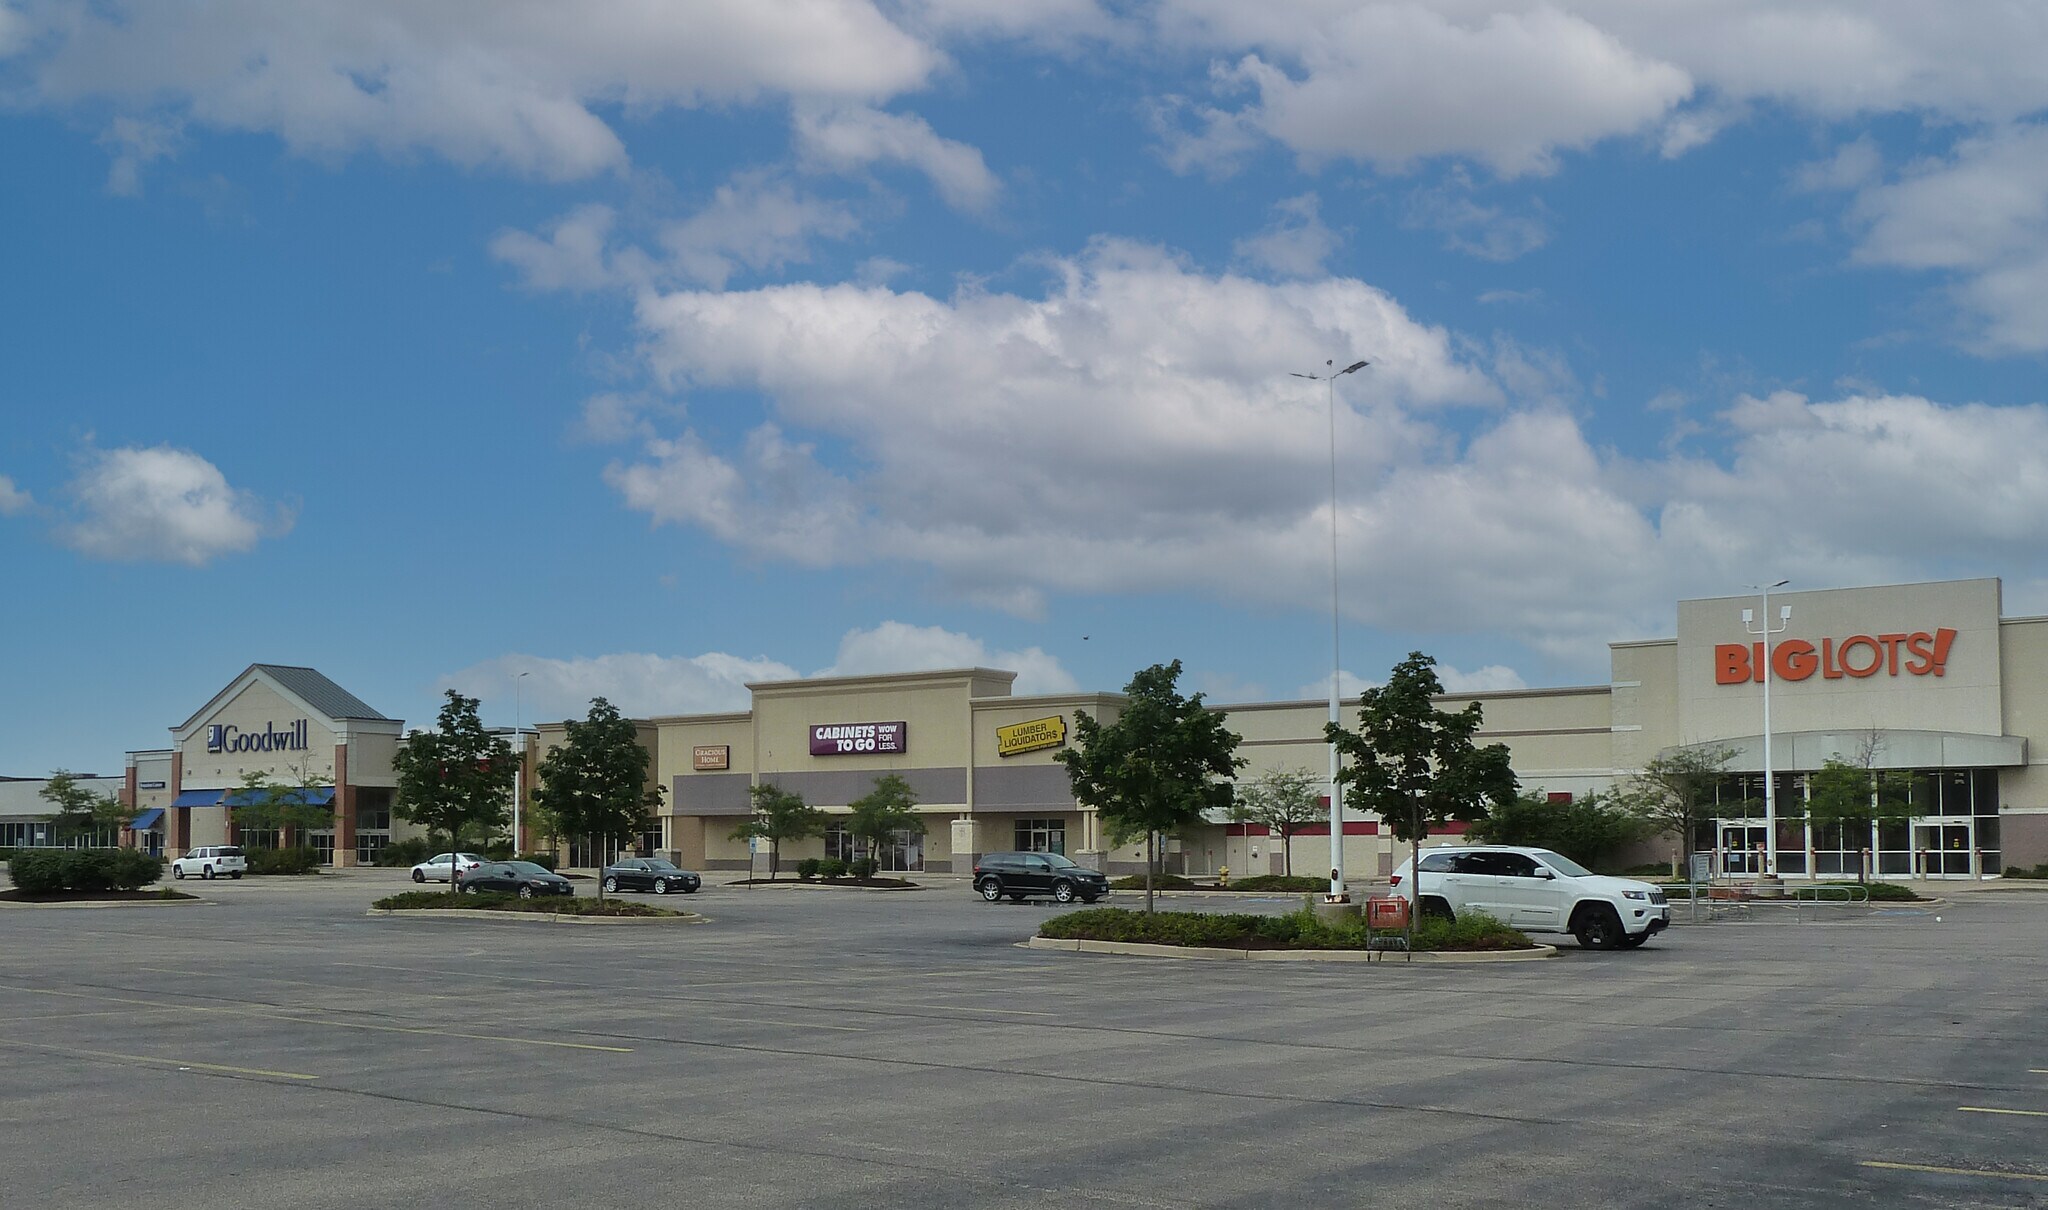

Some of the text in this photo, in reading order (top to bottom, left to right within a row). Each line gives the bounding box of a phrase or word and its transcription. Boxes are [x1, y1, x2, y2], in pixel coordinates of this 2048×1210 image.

[223, 718, 308, 753] Goodwill
[816, 725, 875, 740] CABINETS
[878, 725, 897, 733] WOW
[1012, 723, 1047, 737] LUMBER
[837, 739, 875, 751] TO GO
[878, 742, 897, 750] LESS.
